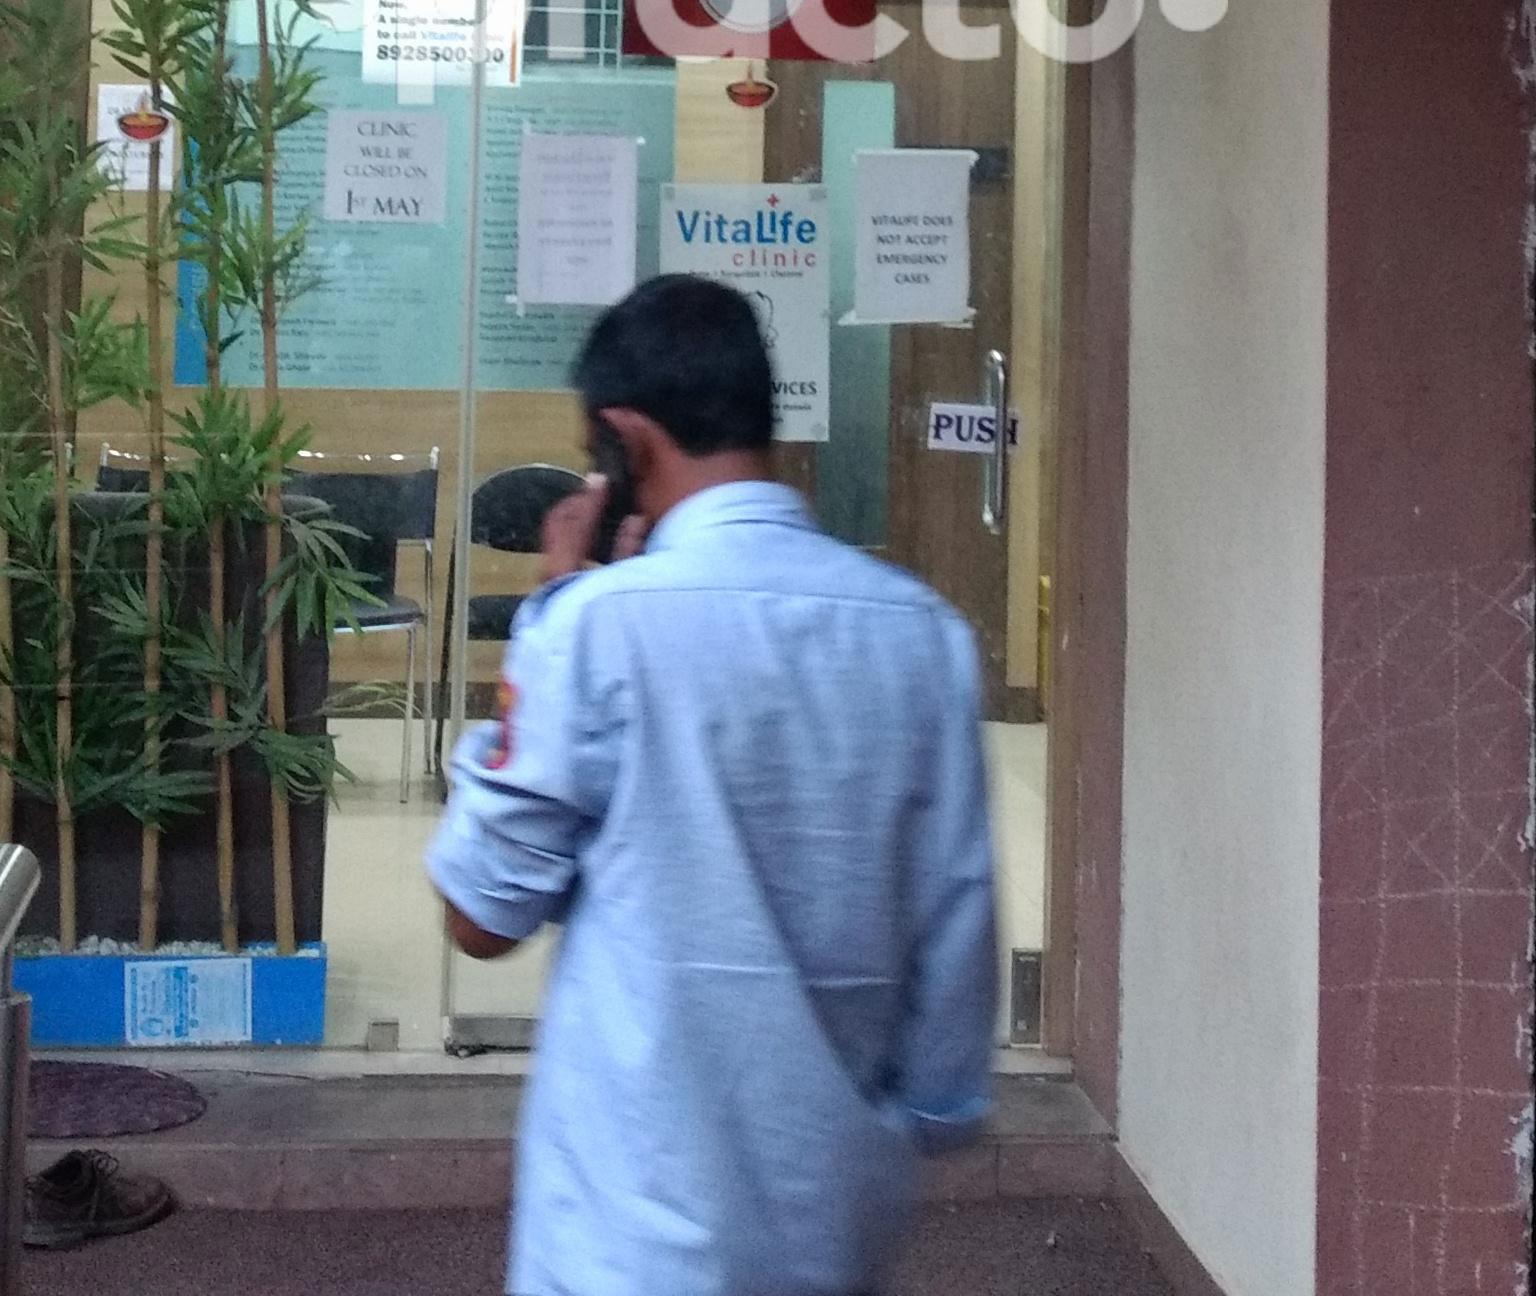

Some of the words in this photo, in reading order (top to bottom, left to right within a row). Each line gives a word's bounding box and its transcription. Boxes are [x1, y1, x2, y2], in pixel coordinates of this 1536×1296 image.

[357, 122, 417, 137] CLINIC
[344, 164, 401, 177] CLOSED
[404, 165, 427, 177] ON
[372, 196, 424, 216] MAY
[732, 250, 816, 267] clinic
[772, 381, 817, 395] VICES
